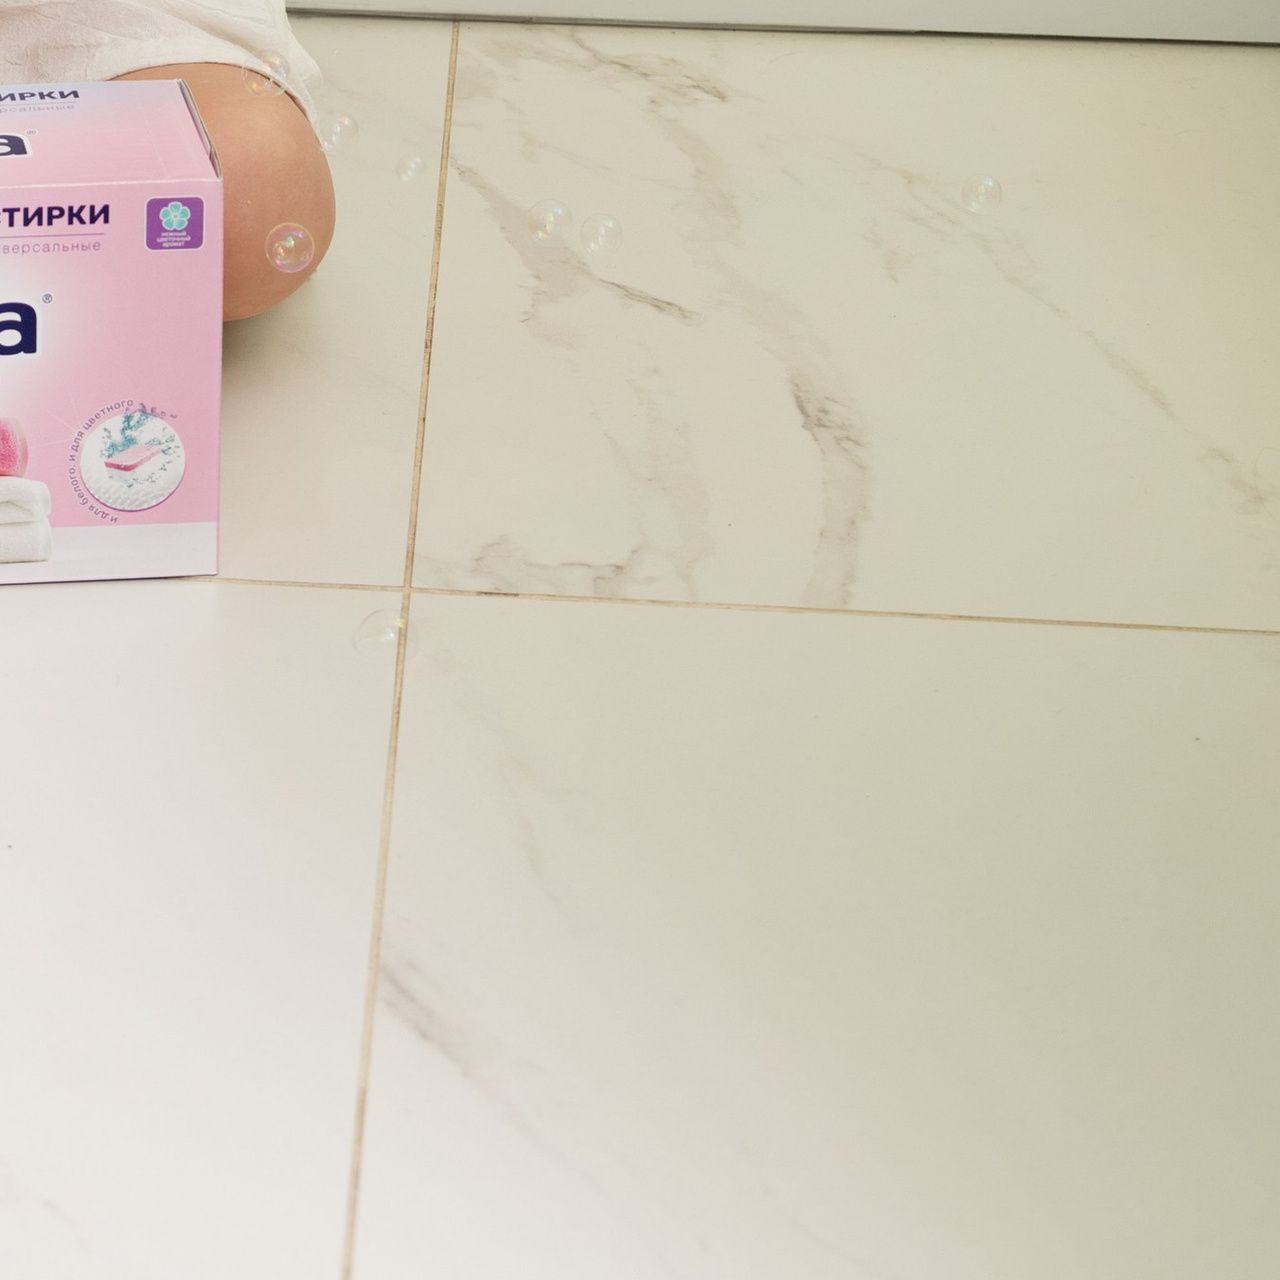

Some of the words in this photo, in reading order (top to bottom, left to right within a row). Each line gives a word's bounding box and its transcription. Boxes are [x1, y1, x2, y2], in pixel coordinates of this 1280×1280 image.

[83, 399, 134, 431] цветного
[71, 431, 84, 453] для
[88, 503, 109, 520] для
